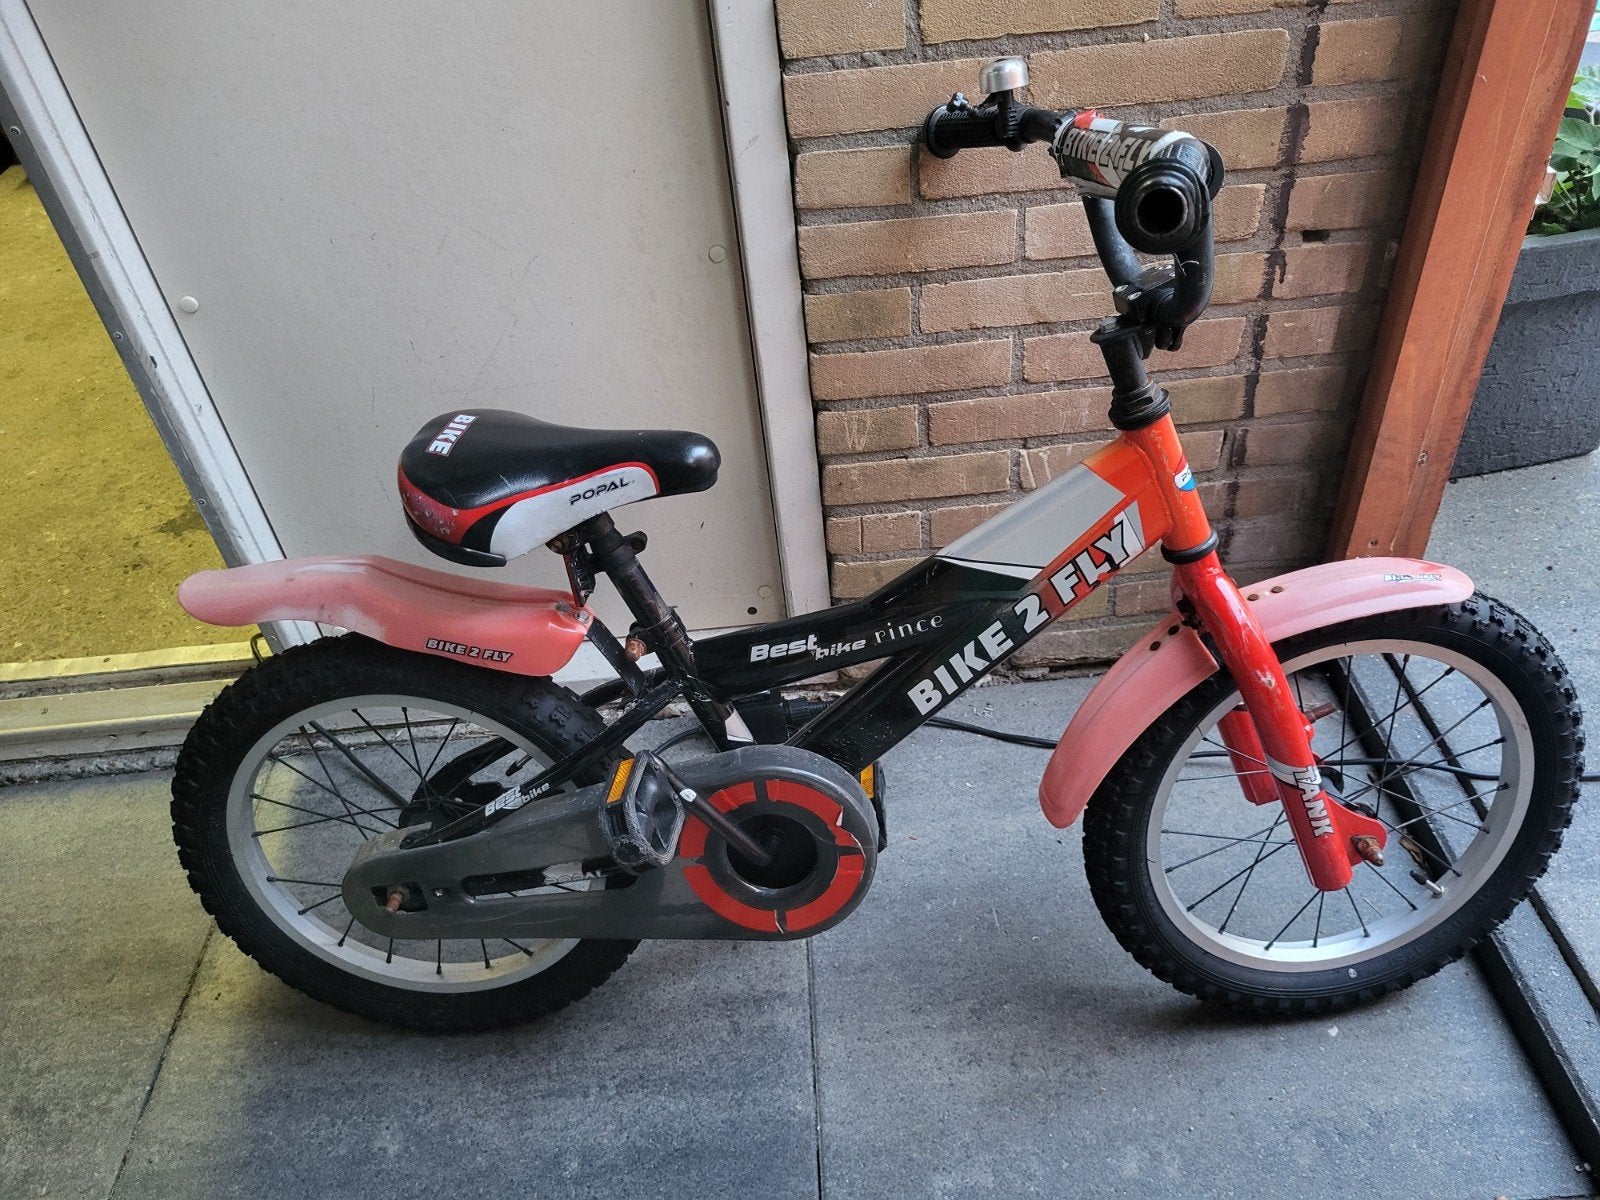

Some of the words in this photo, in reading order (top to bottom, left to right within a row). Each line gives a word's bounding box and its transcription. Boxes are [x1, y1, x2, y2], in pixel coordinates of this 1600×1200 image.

[427, 414, 478, 456] BIKE
[570, 477, 629, 506] POPAL
[907, 620, 1015, 716] BIKE
[1013, 593, 1051, 635] 2
[1048, 519, 1130, 606] FLY
[426, 638, 468, 657] BIKE
[468, 645, 481, 658] 2
[482, 647, 514, 664] FLY
[750, 634, 818, 663] Best
[814, 639, 867, 661] bike
[484, 785, 522, 817] Best
[521, 782, 551, 804] bike
[1293, 765, 1335, 838] TANK
